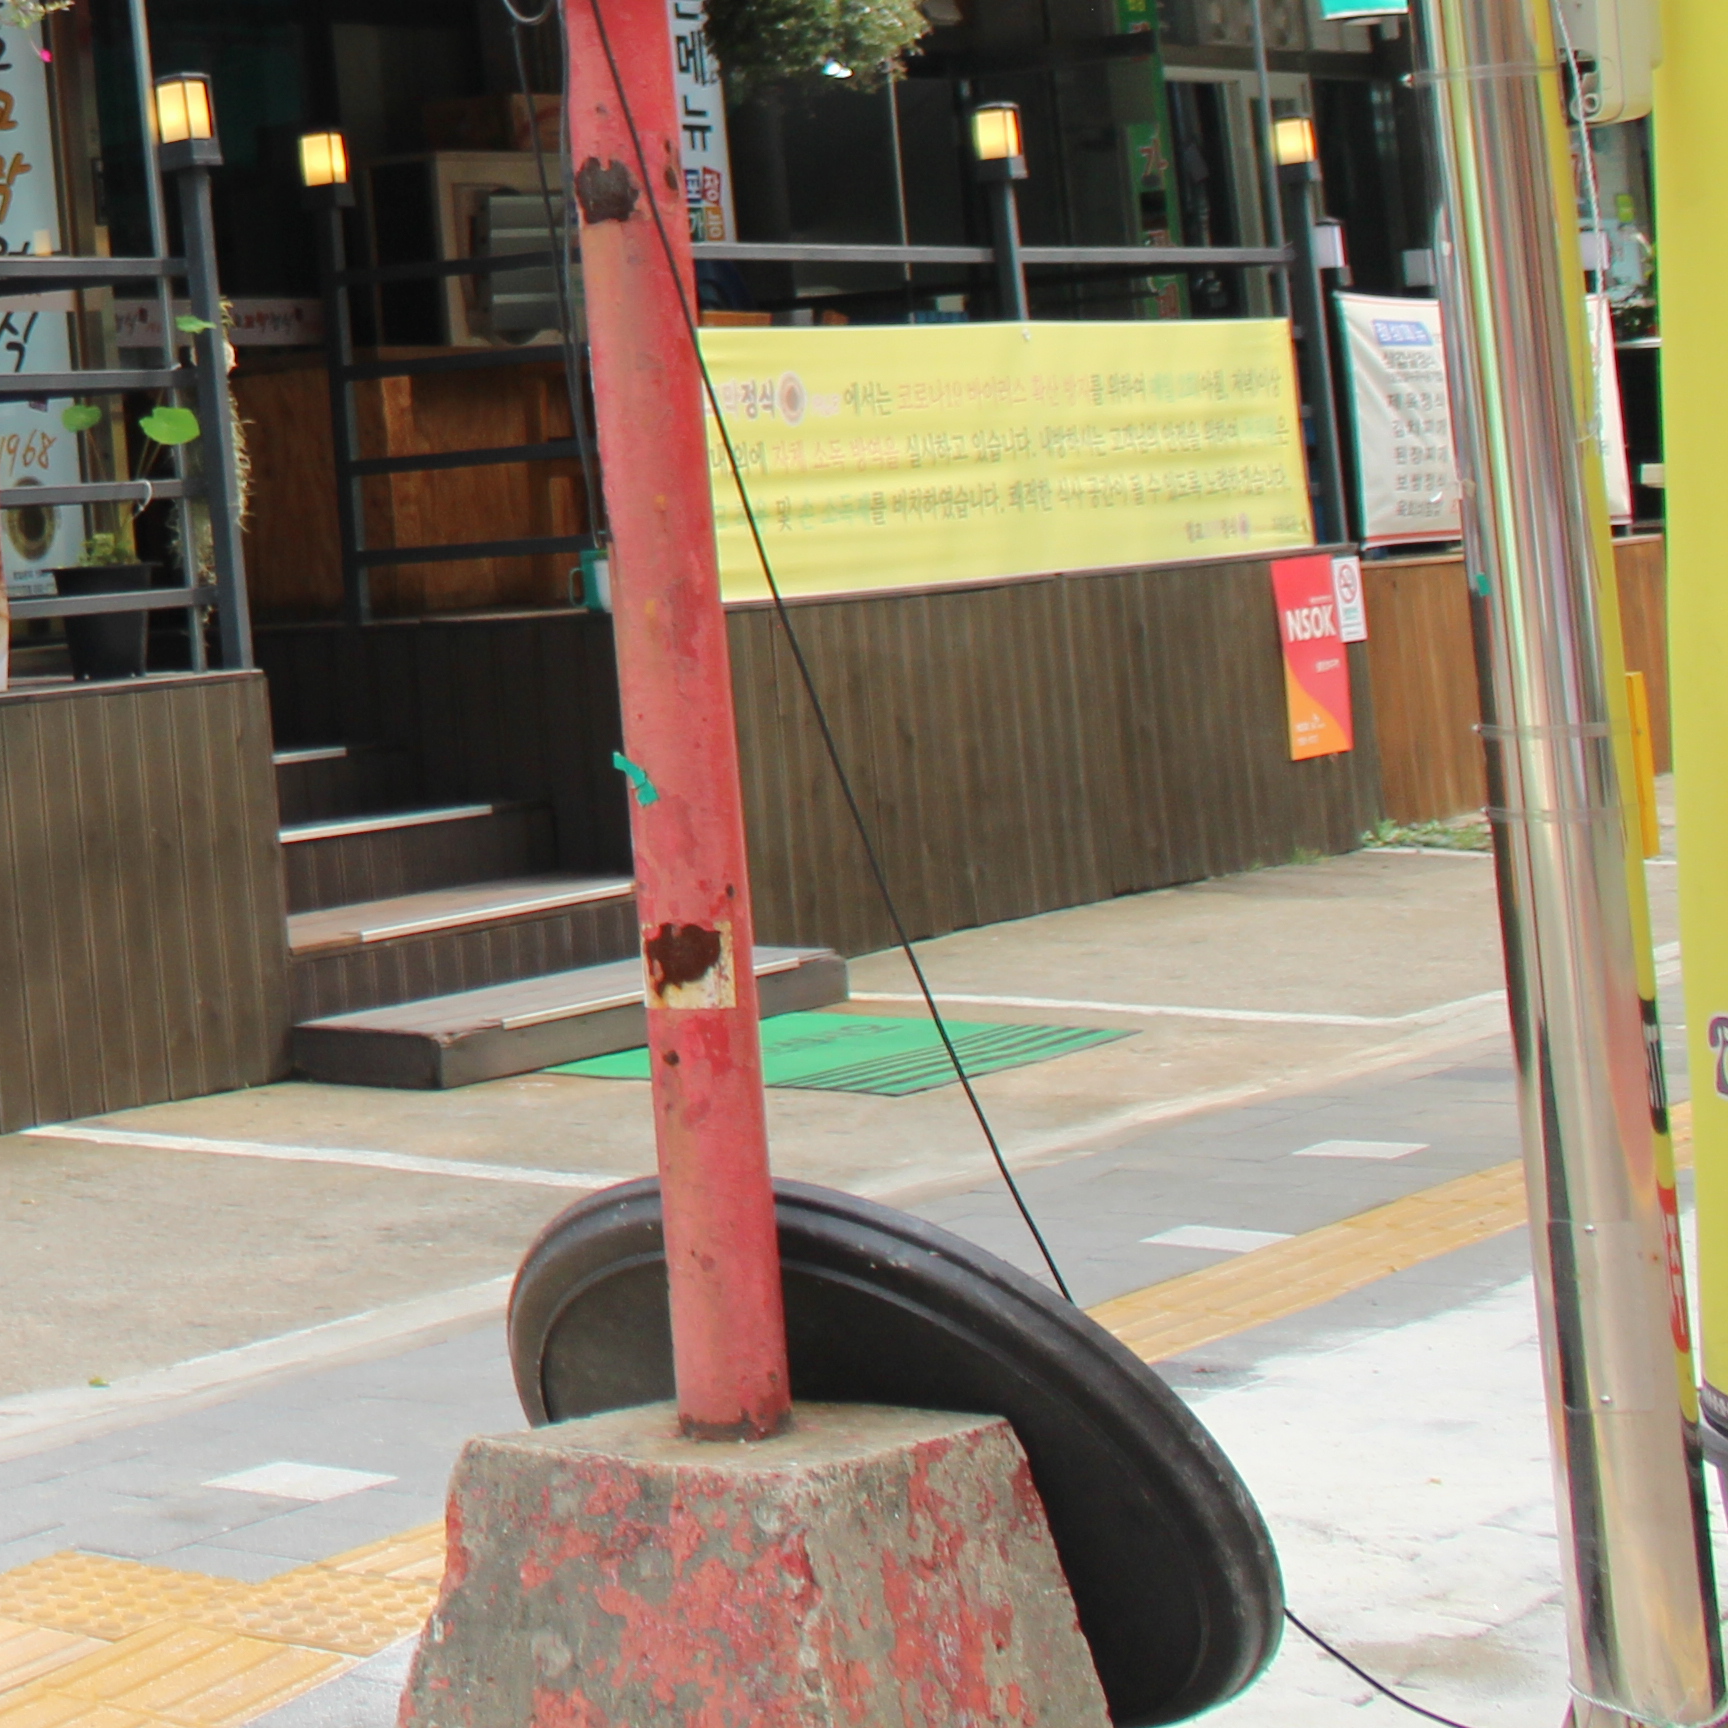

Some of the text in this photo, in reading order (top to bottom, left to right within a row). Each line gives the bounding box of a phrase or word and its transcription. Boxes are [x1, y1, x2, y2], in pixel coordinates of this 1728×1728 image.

[842, 380, 894, 417] 에서는
[897, 377, 964, 411] 코로나19
[813, 438, 846, 472] 소독
[848, 435, 900, 472] 방역을
[905, 430, 970, 470] 실시하고
[971, 426, 1038, 464] 있습니다.
[774, 494, 793, 533] 및
[890, 480, 1006, 523] 비치하였습니다.
[1285, 602, 1338, 643] NSOK
